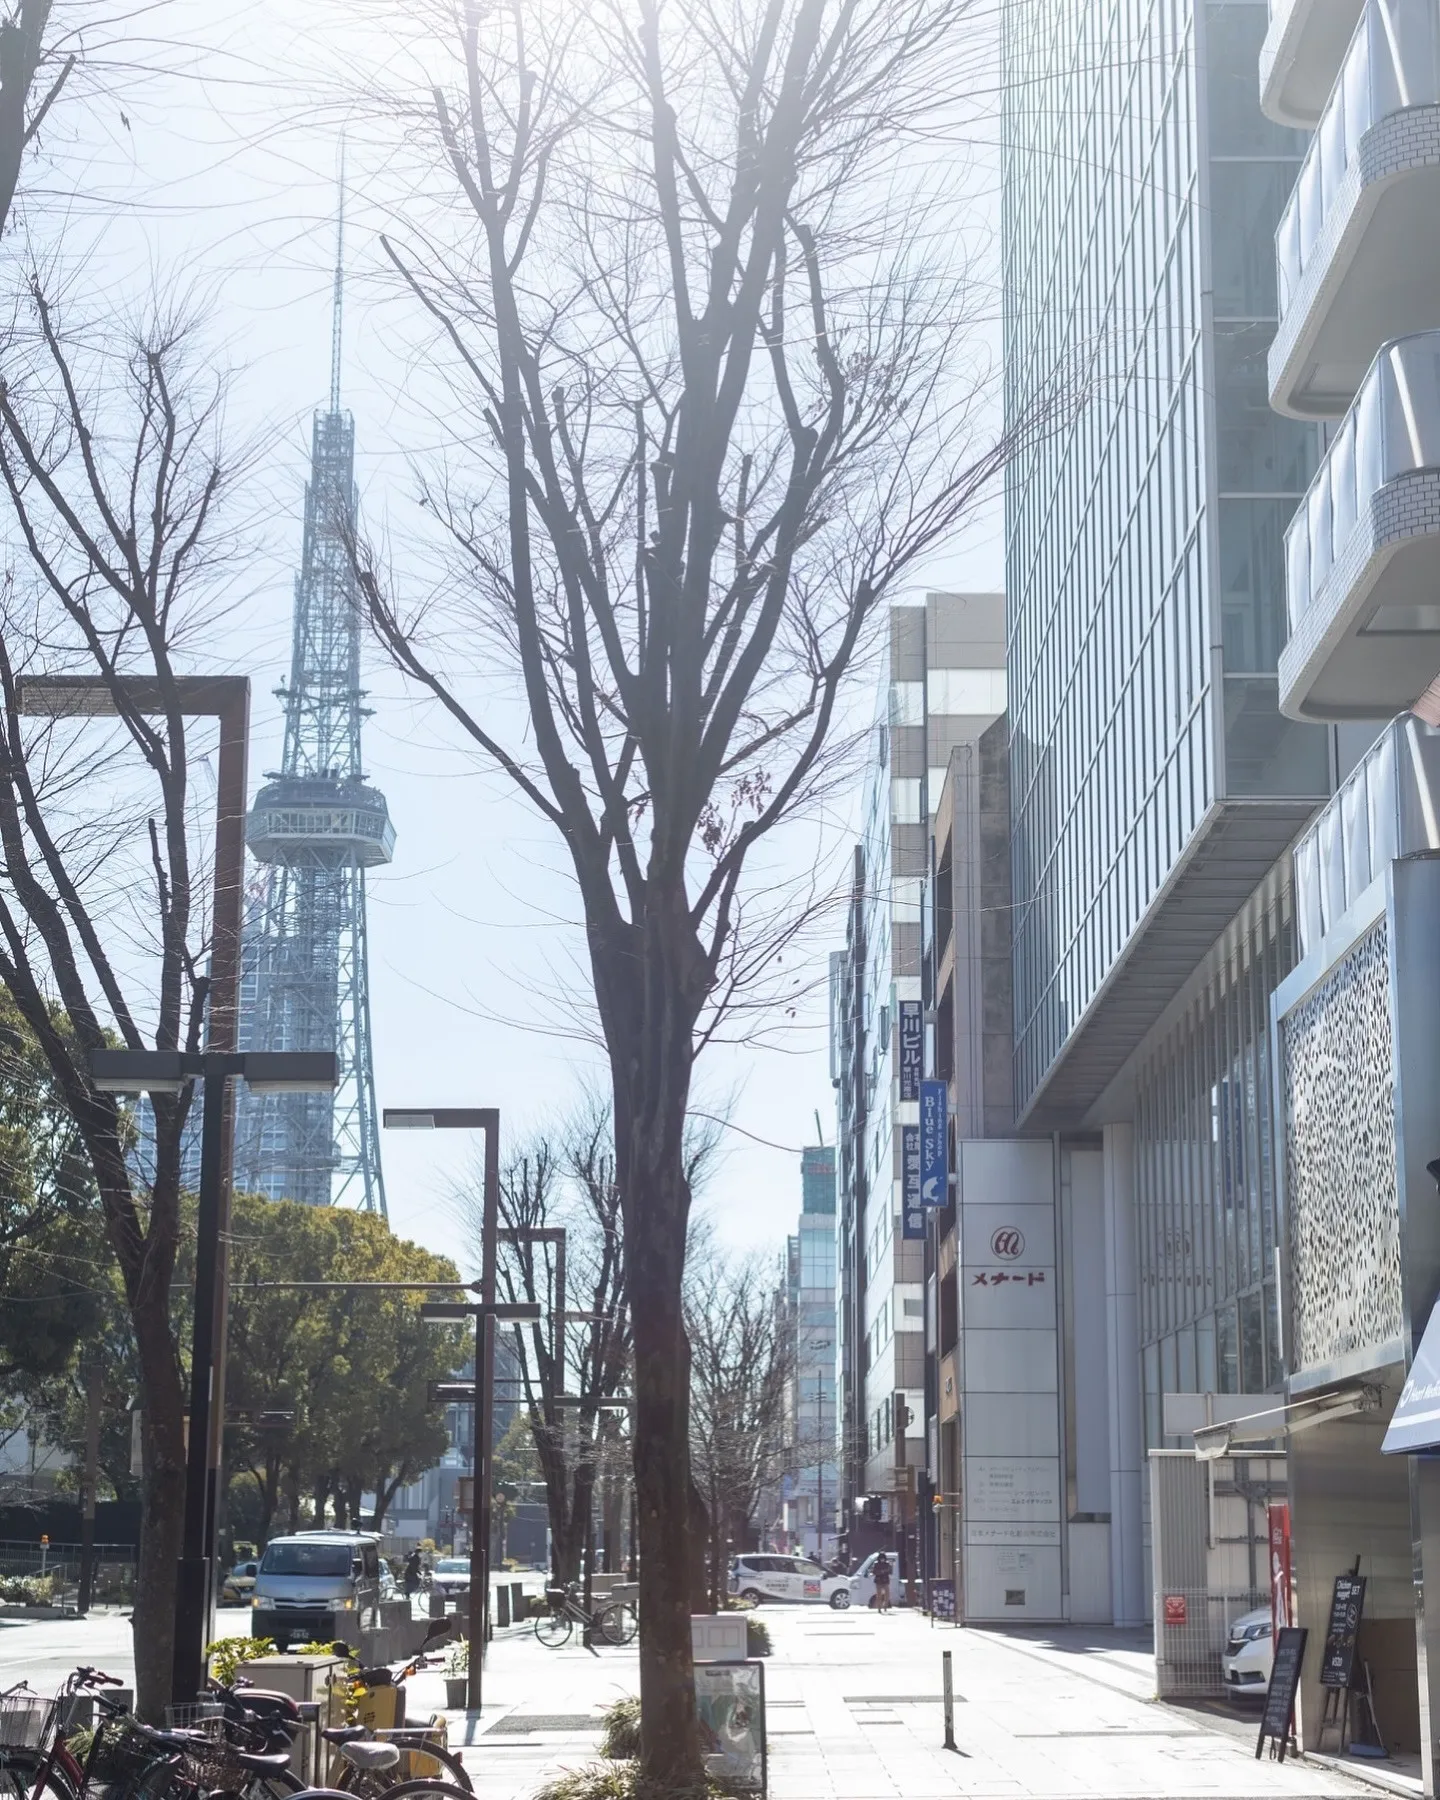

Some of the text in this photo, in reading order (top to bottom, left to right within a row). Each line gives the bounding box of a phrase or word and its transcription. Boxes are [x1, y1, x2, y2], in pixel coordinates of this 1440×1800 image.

[902, 1002, 921, 1065] 早川ビル
[925, 1096, 935, 1171] Blue Sky
[971, 1272, 1045, 1286] メナード
